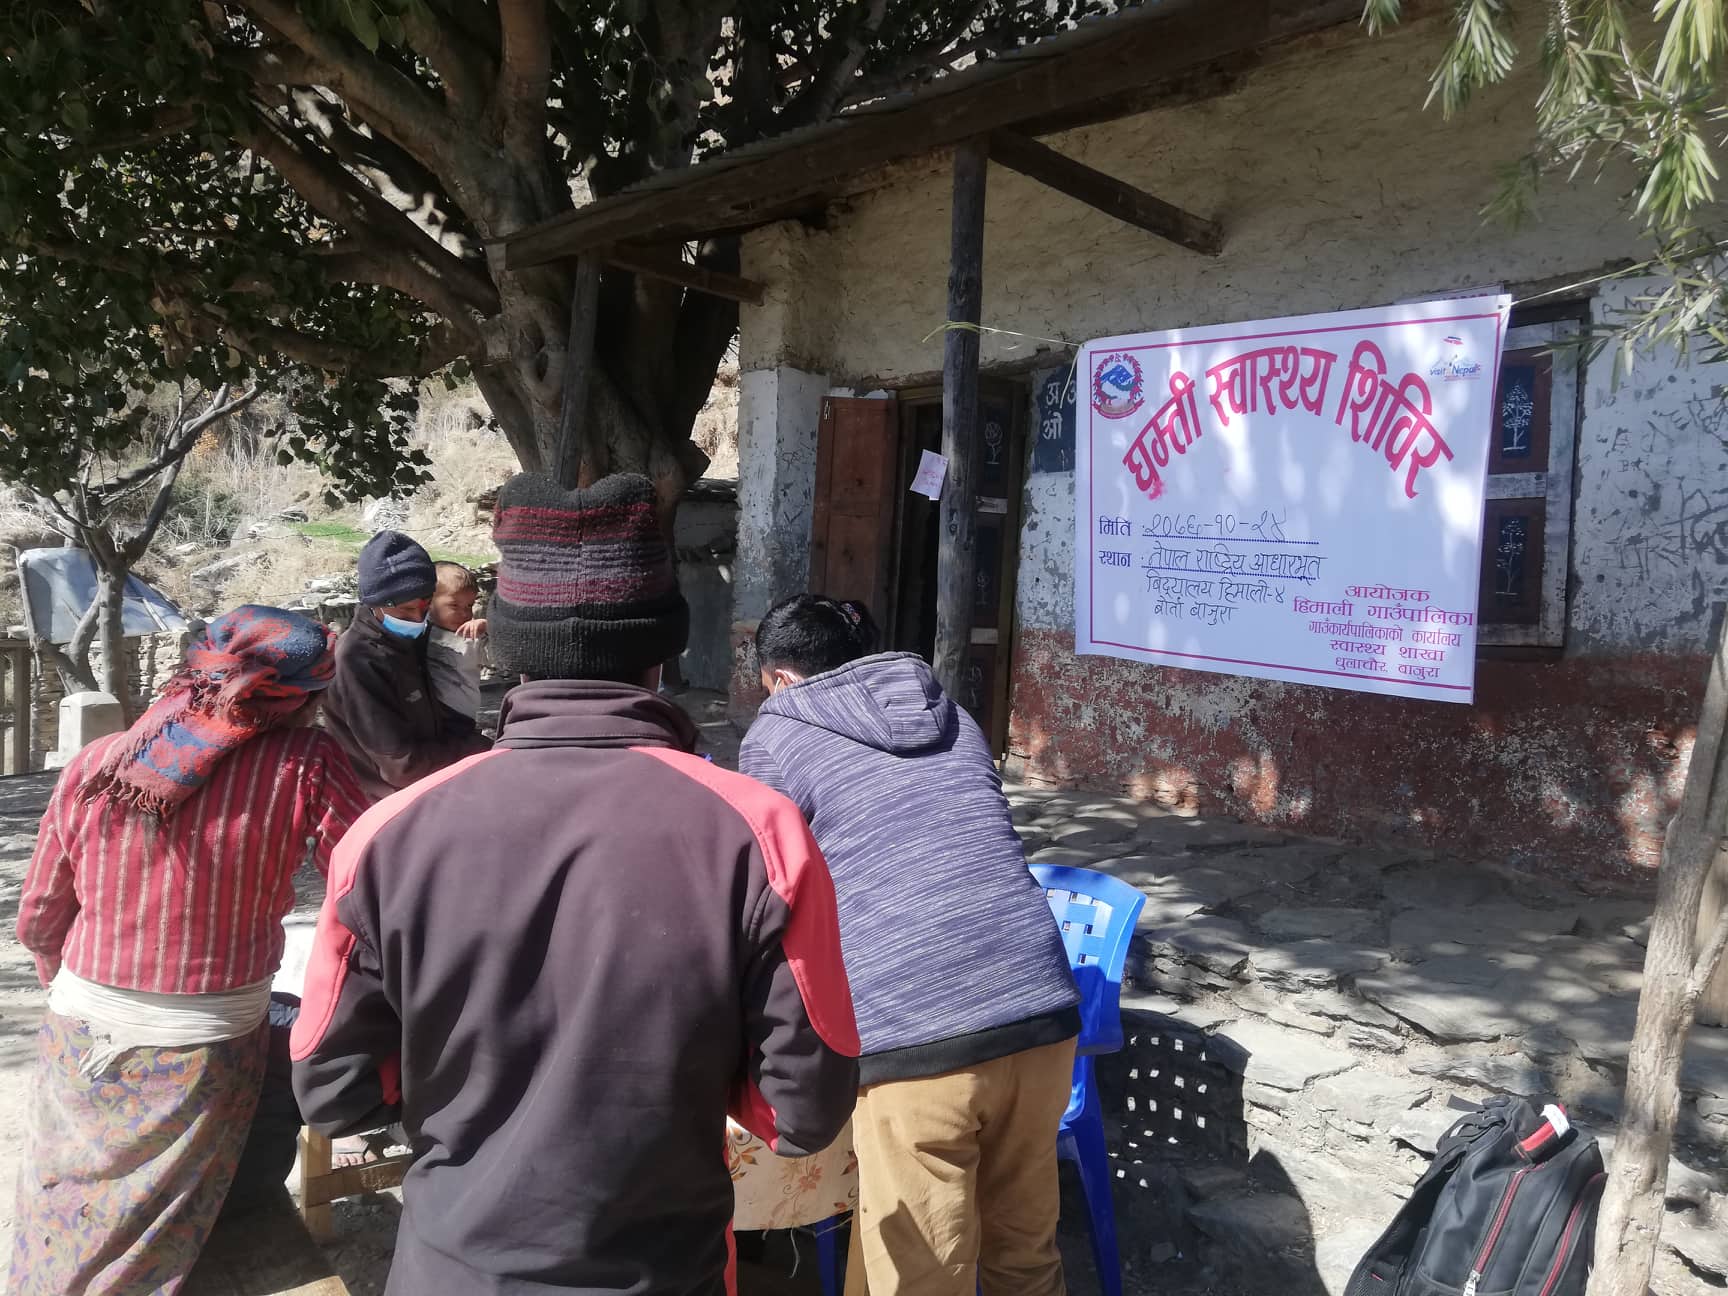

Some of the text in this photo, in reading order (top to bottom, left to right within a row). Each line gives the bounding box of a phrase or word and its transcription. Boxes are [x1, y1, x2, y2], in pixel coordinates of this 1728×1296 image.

[1205, 345, 1338, 427] स्वास्थ्य
[1335, 340, 1454, 499] शिविर
[1099, 516, 1131, 537] मिति
[1099, 551, 1131, 567] स्थान
[1345, 584, 1430, 602] आयोजक
[1293, 596, 1354, 616] हिमाली
[1399, 646, 1445, 661] शाखा
